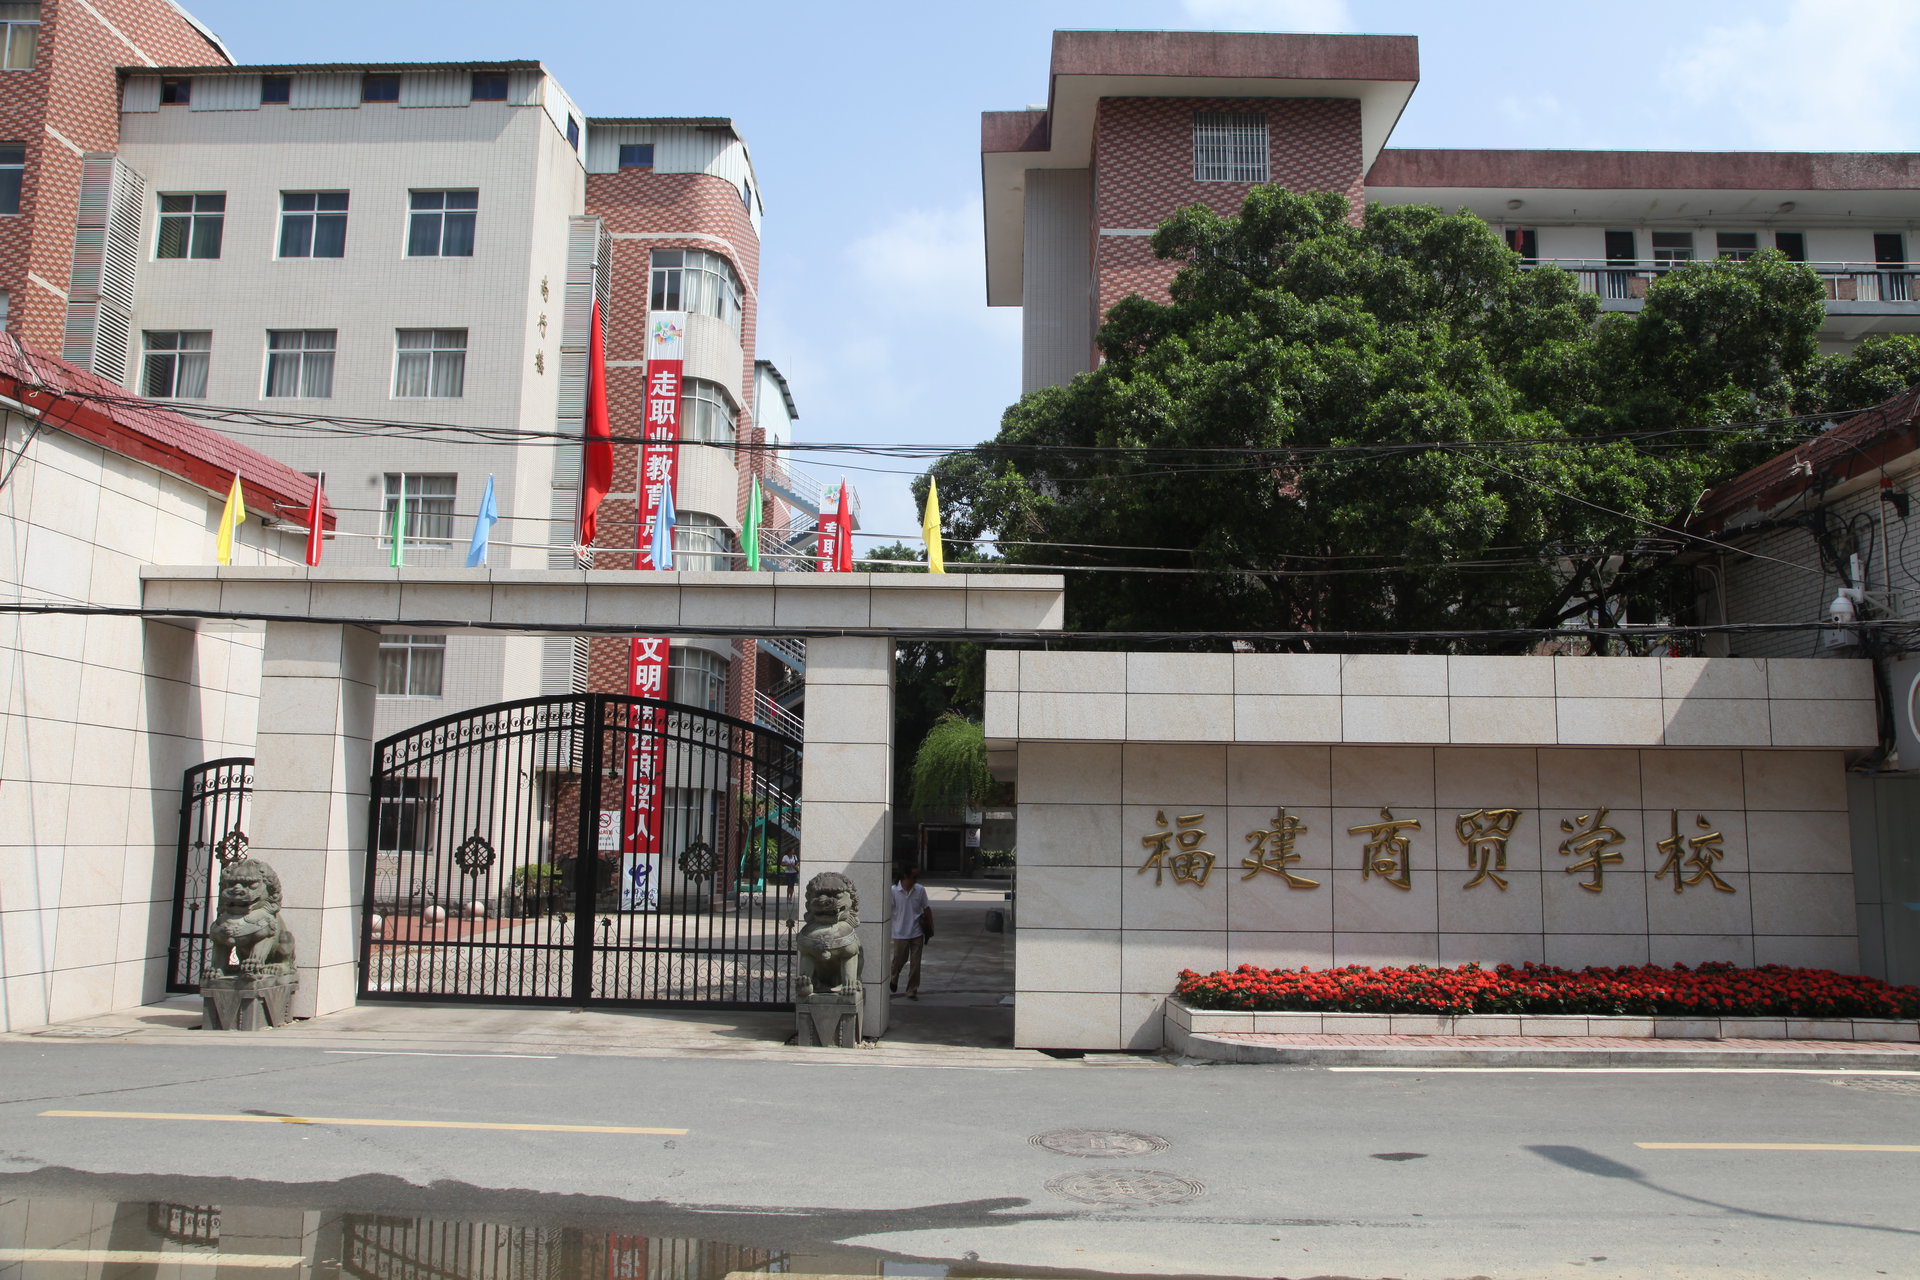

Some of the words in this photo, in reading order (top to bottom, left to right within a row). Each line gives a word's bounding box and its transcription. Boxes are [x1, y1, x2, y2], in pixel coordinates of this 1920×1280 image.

[1137, 805, 1737, 894] 福建商贸学校
